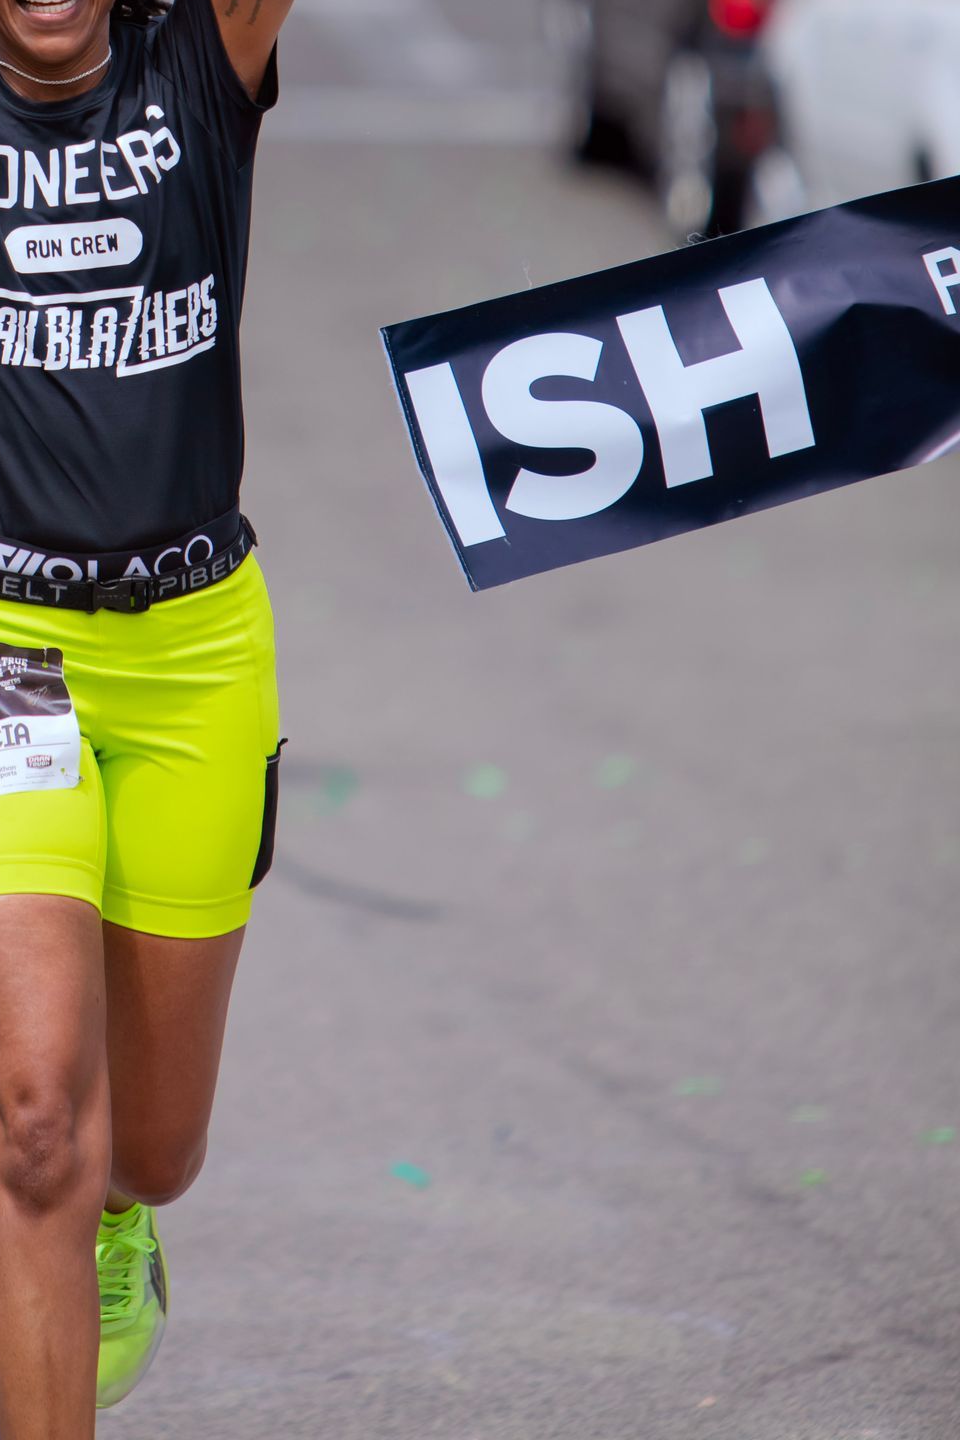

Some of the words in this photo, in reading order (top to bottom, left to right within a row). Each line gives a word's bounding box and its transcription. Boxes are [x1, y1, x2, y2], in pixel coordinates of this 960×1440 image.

[26, 238, 63, 260] RUN
[70, 233, 119, 257] CREW
[404, 277, 816, 547] ISH
